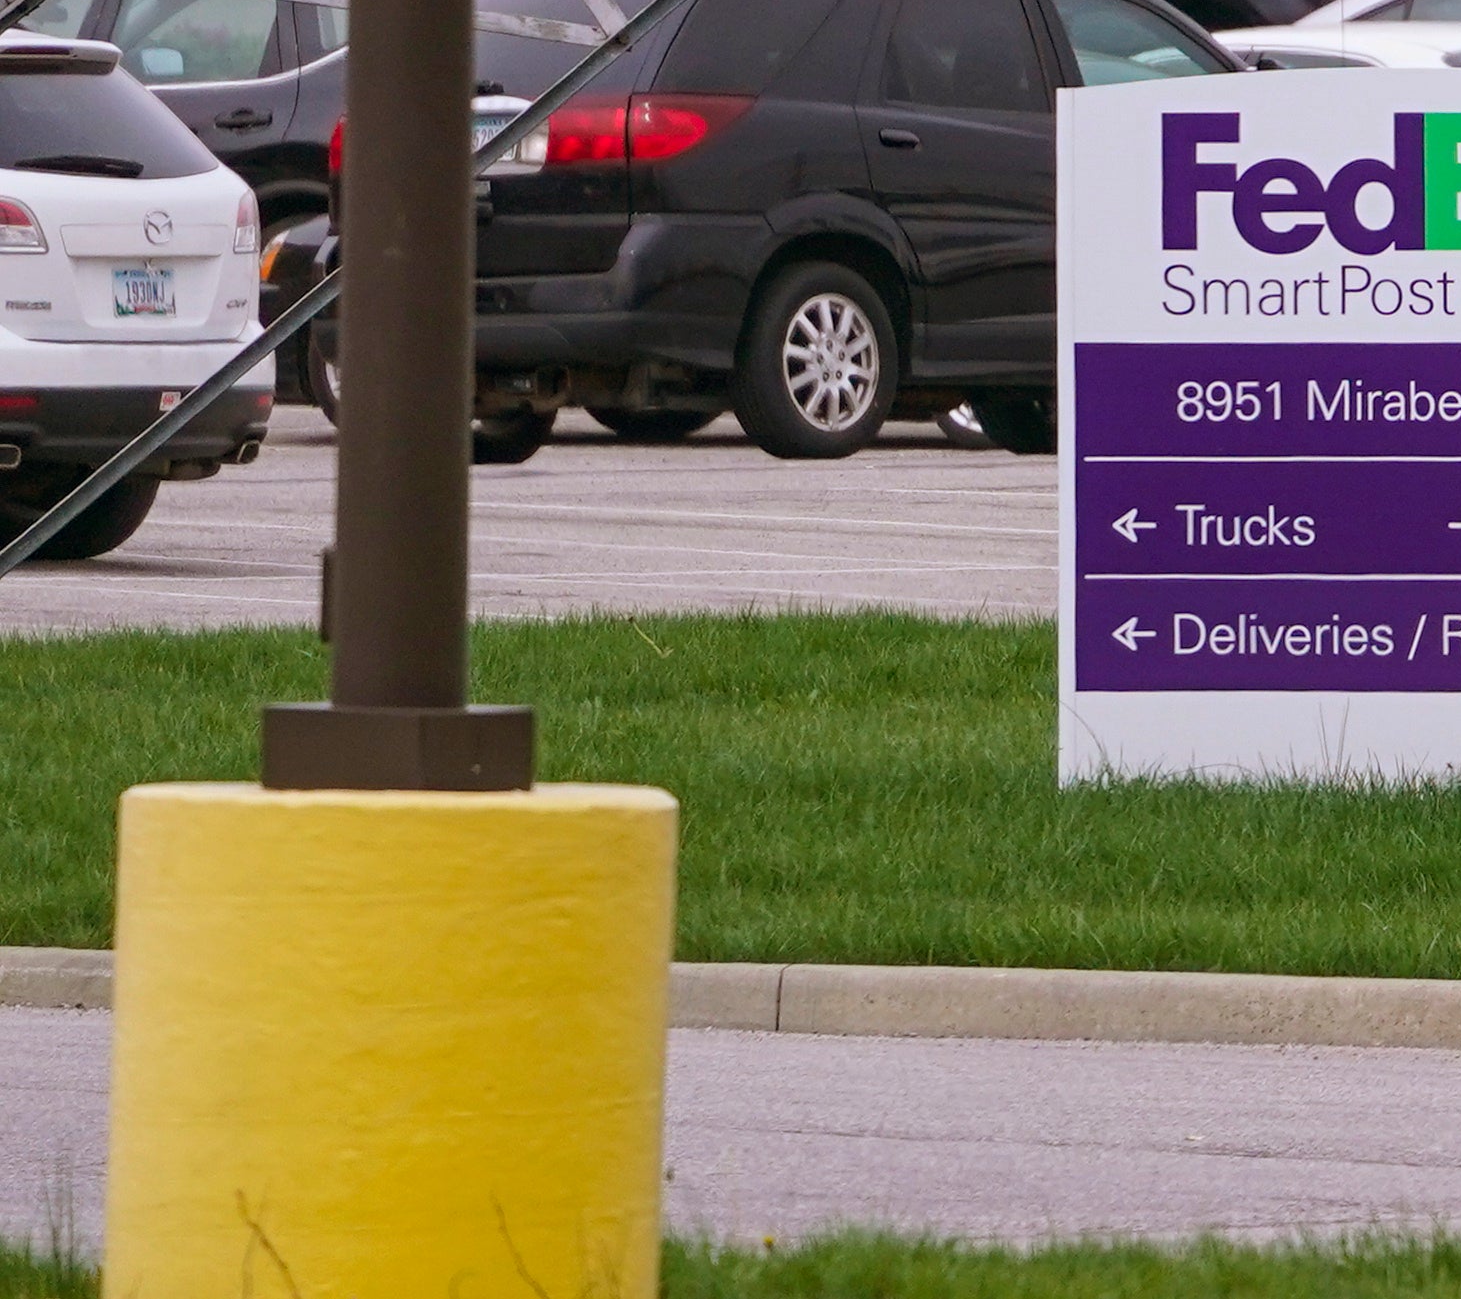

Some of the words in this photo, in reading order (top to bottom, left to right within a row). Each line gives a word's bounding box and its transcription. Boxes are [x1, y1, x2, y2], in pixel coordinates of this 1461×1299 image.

[1162, 264, 1455, 316] SmartPost
[1177, 381, 1281, 422] 8951
[1175, 504, 1316, 546] Trucks
[1174, 613, 1394, 656] Deliveries
